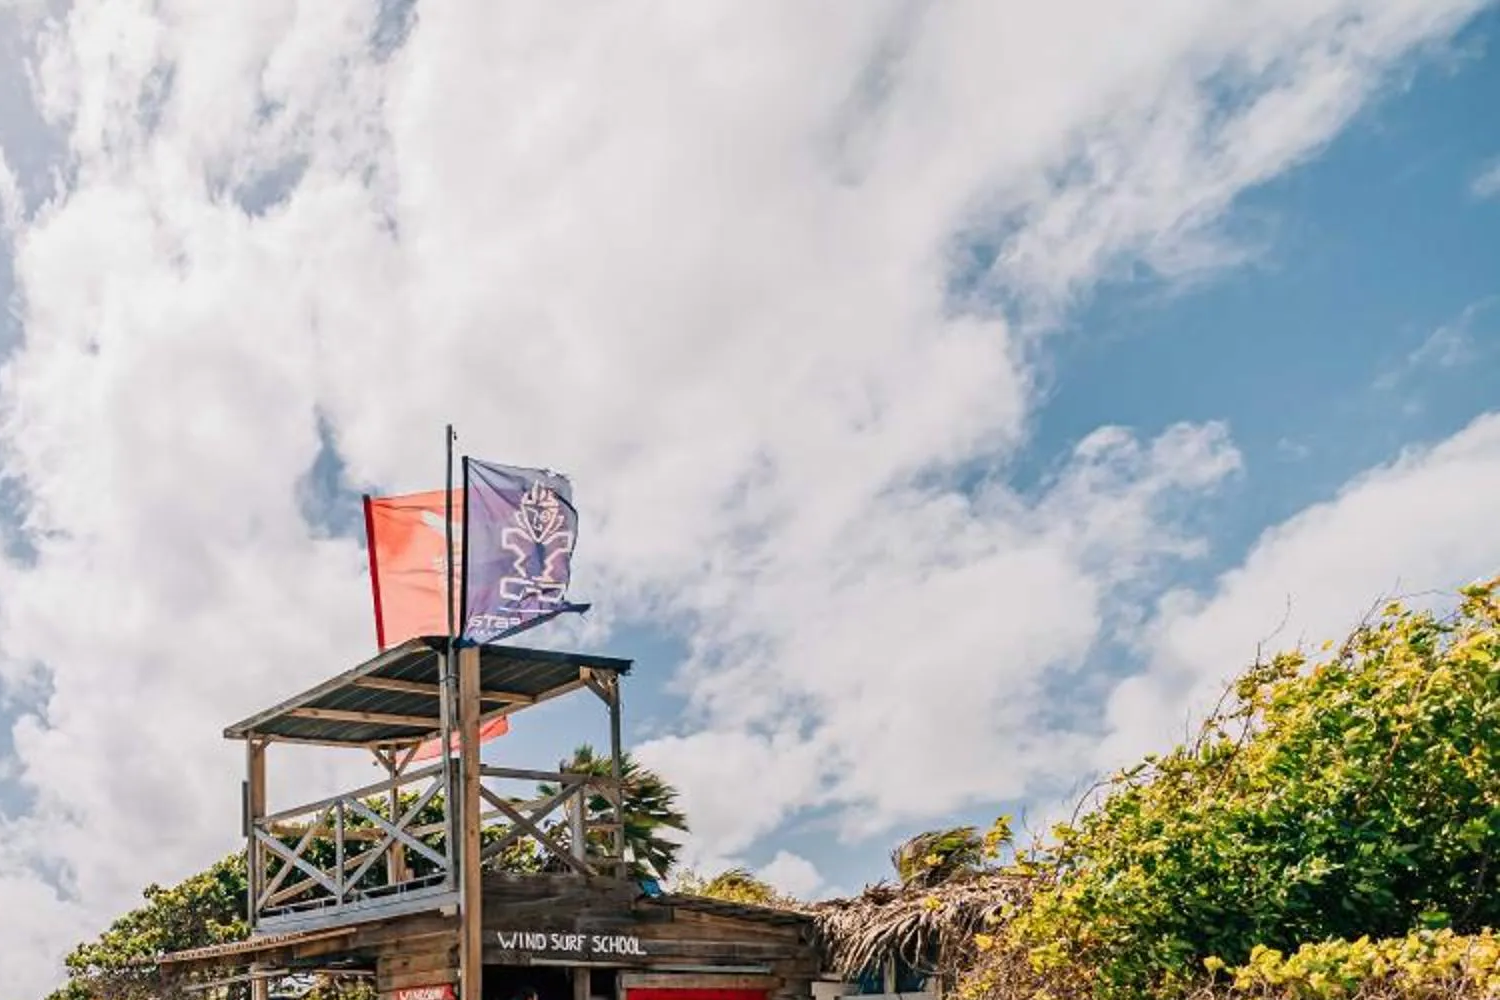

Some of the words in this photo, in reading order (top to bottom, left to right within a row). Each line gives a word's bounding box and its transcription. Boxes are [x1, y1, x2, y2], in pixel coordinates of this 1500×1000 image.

[497, 931, 547, 950] WIND
[550, 933, 587, 951] SURF
[591, 935, 648, 955] SCHOOL
